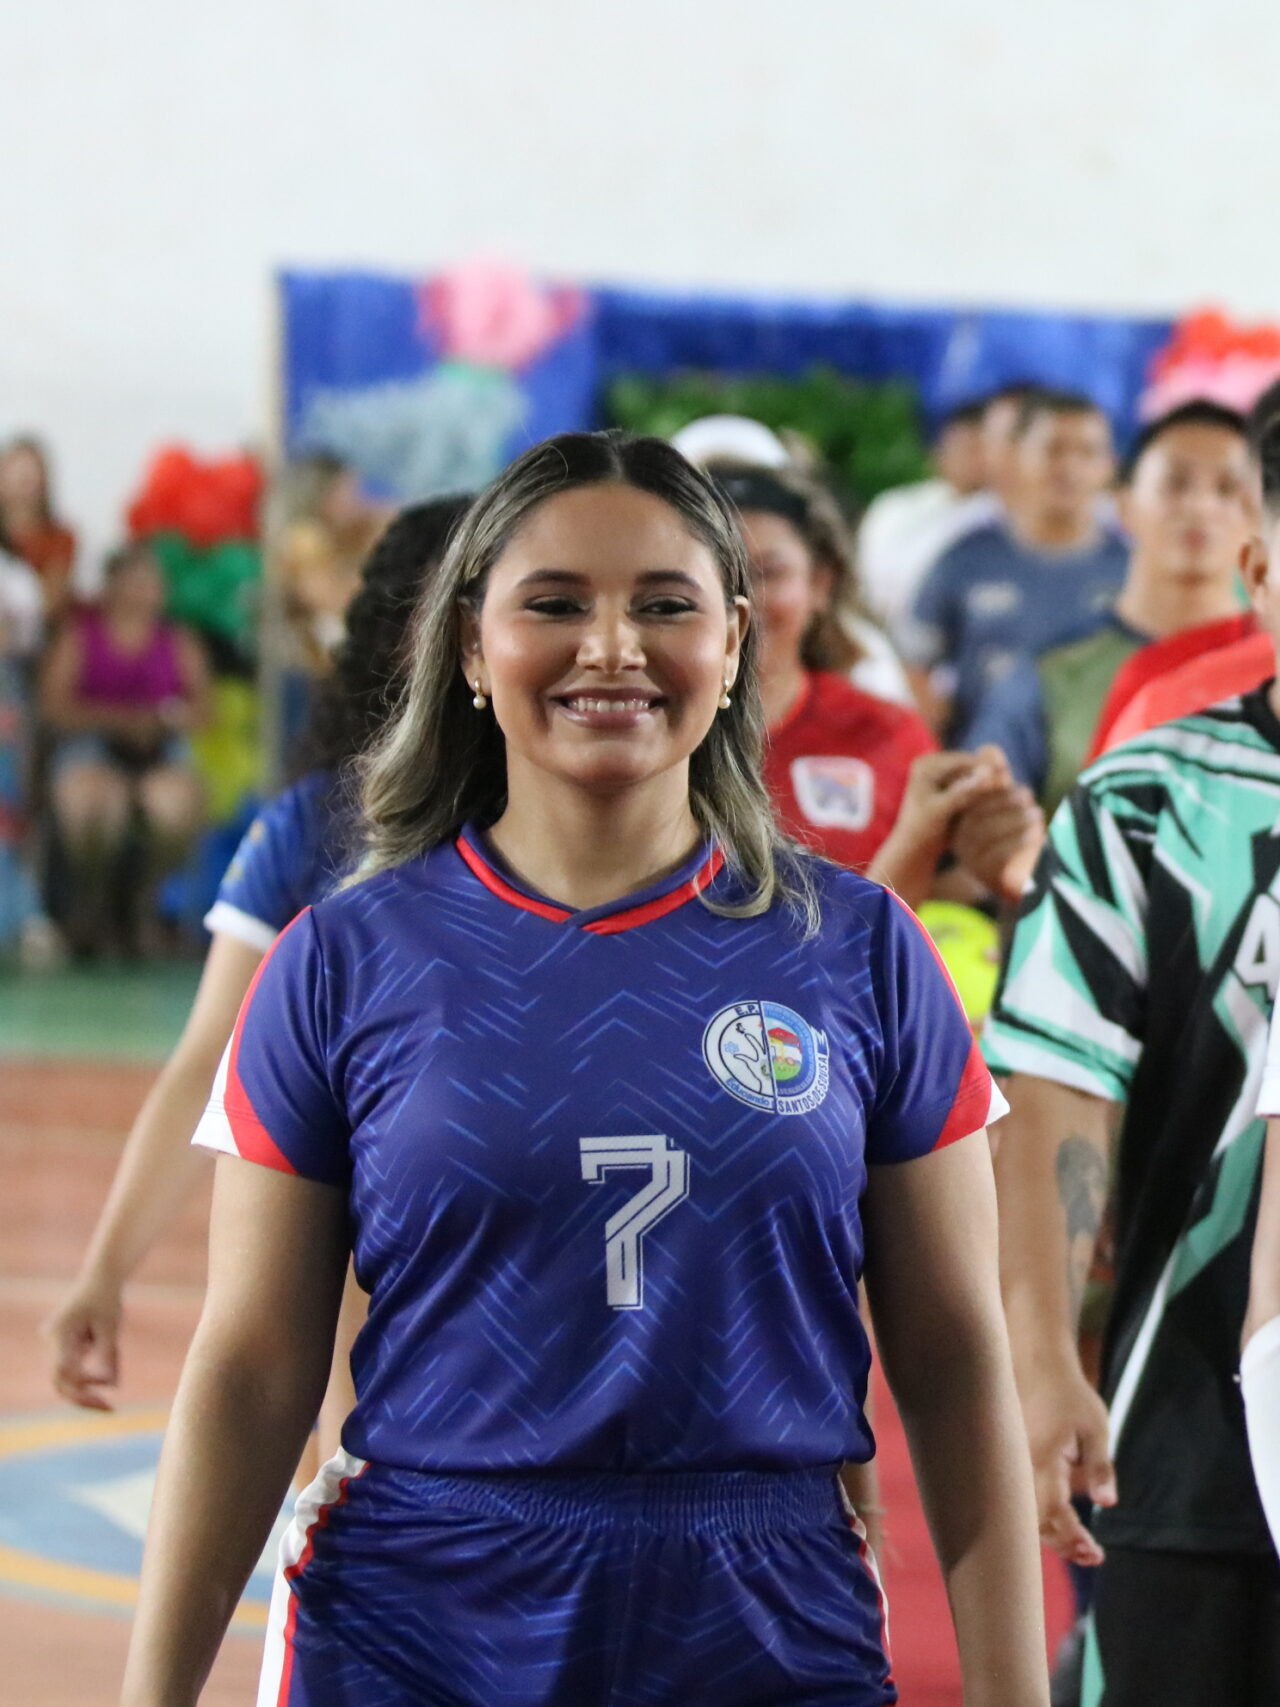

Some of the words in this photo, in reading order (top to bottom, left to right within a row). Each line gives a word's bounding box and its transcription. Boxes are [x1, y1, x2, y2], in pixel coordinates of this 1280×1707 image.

[734, 1004, 760, 1016] E.P.
[778, 1093, 817, 1113] SANTOS
[817, 1056, 830, 1090] SOUSA
[579, 1134, 691, 1310] 7
